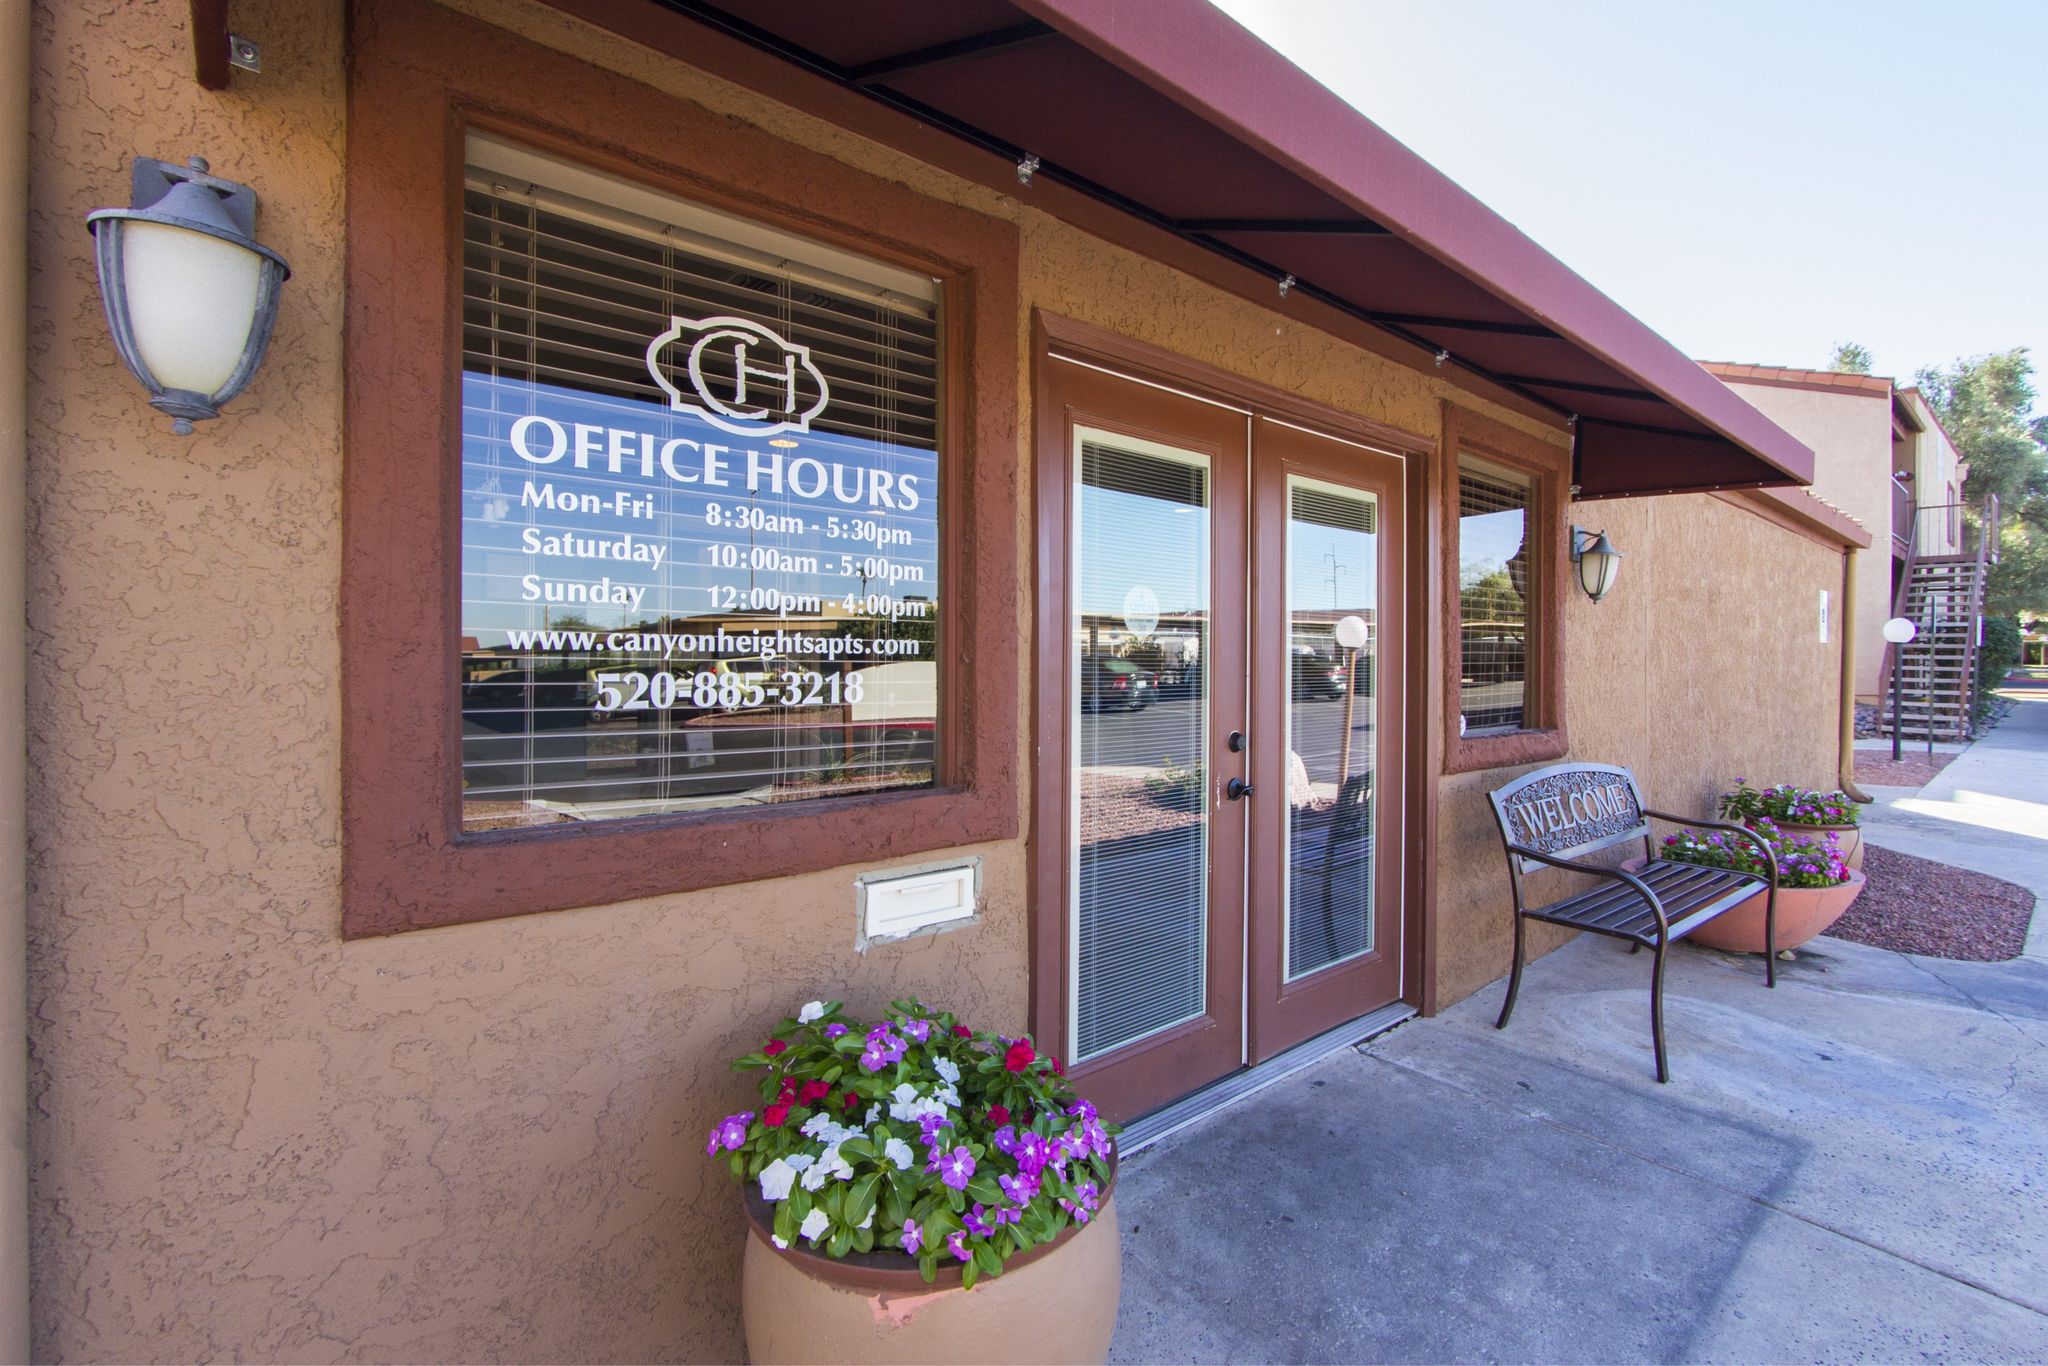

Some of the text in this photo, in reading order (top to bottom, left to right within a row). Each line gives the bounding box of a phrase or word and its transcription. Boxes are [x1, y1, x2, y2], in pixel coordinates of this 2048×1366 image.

[510, 415, 919, 511] OFFICE HOURS
[521, 481, 654, 520] Mon-Fri
[705, 502, 804, 535] 8:30am
[826, 516, 912, 549] 5:30pm
[522, 527, 667, 571] Saturday
[706, 543, 818, 574] 10:00am
[839, 555, 924, 586] 5:00pm
[521, 574, 646, 613] Sunday
[706, 584, 820, 618] 12:00pm
[842, 592, 926, 623] 4:00pm
[506, 627, 920, 661] www.canyonheightsapts.com
[595, 669, 865, 713] 520-885-3218
[1514, 783, 1631, 839] WELCOME
